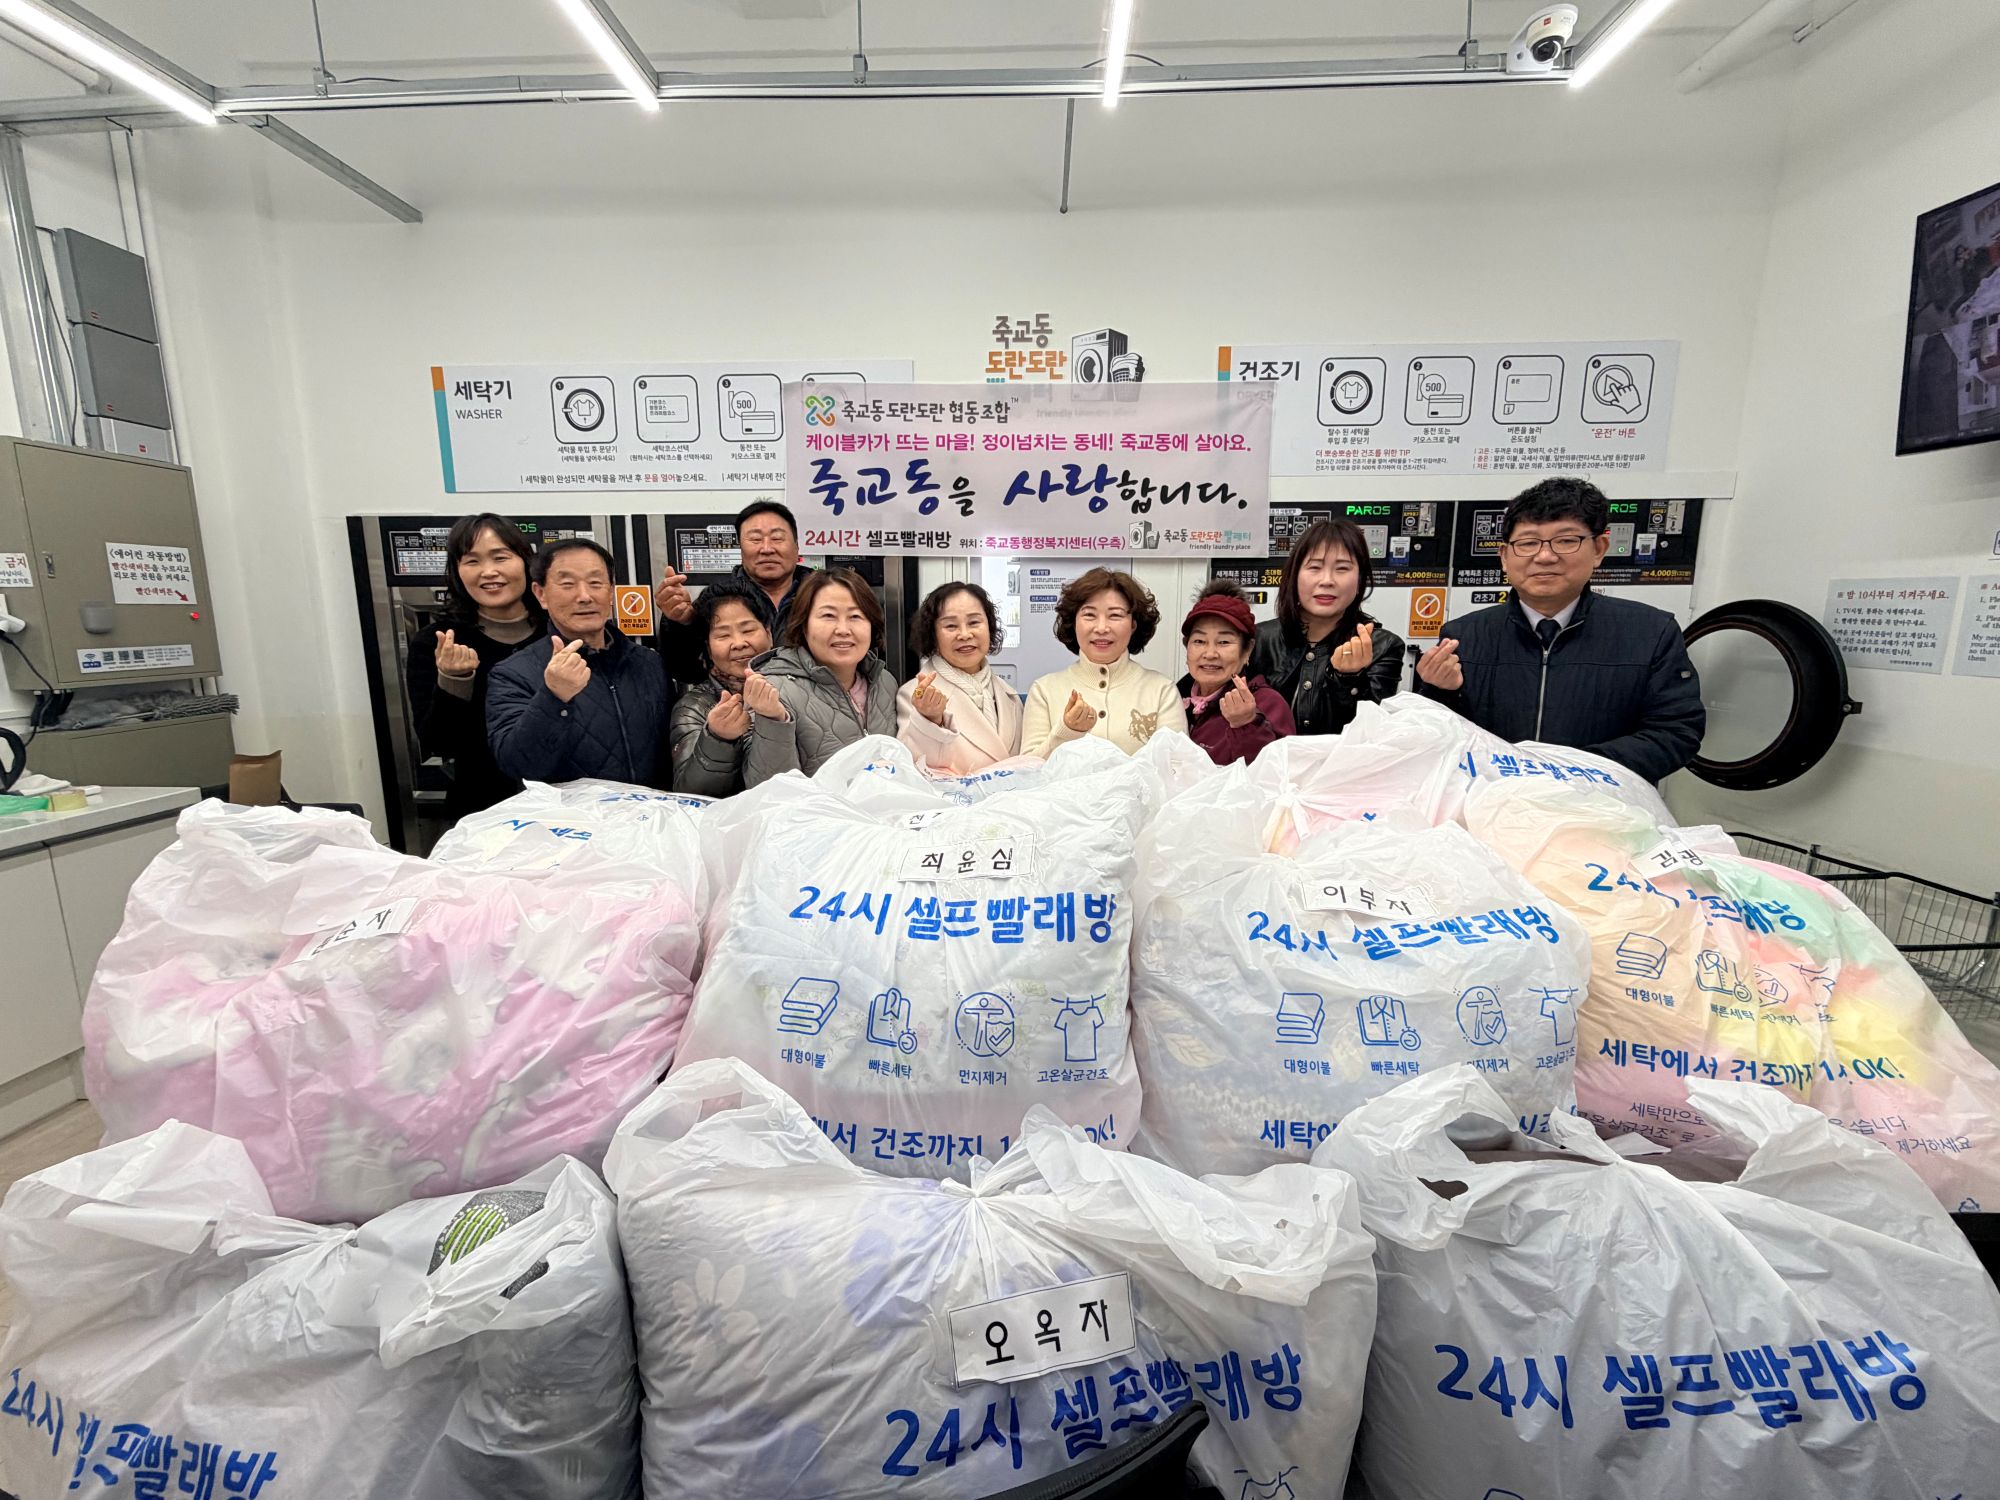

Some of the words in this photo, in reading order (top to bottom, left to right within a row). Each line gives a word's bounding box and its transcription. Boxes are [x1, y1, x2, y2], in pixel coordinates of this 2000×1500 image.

[992, 313, 1053, 349] 죽교동
[985, 351, 1068, 380] 도란도란
[455, 380, 512, 403] 세탁기
[1425, 382, 1441, 392] 500
[736, 400, 752, 409] 500
[455, 409, 503, 419] WASHER
[1413, 436, 1445, 444] 키오스크로
[1618, 428, 1637, 438] 버튼
[806, 433, 890, 452] 케이블카가
[895, 433, 929, 451] 뜨는
[935, 433, 975, 451] 마을!
[982, 433, 1068, 451] 정이넘치는
[1073, 432, 1113, 451] 동네!
[1120, 433, 1189, 452] 죽교동에
[1195, 433, 1252, 452] 살아요.
[731, 452, 762, 460] 키오스크로
[1324, 449, 1359, 457] 뽀송뽀송한
[525, 475, 554, 484] 세탁물이
[556, 474, 585, 483] 완성되면
[587, 474, 616, 483] 세탁물을
[618, 474, 632, 483] 꺼낸
[726, 473, 748, 482] 세탁기
[751, 472, 774, 481] 내부에
[808, 458, 976, 517] 죽교동을
[1002, 463, 1248, 514] 사랑합니다.
[1346, 505, 1391, 516] PAROS
[805, 530, 861, 547] 24시간
[866, 530, 952, 549] 셀프빨래방
[959, 538, 977, 549] 위치
[985, 536, 1126, 550] 죽교동행정복지센터(우측)
[1163, 529, 1187, 543] 죽교동
[1189, 529, 1222, 543] 도란도란
[1189, 543, 1212, 551] friendly
[1213, 543, 1234, 551] laundry
[1235, 543, 1251, 551] place
[5, 556, 27, 568] 금지
[135, 587, 174, 596] 빨간색버튼
[1257, 592, 1263, 604] 1
[1473, 593, 1496, 602] 건조기
[1498, 592, 1507, 603] 2
[1858, 590, 1895, 599] 10시부터
[1898, 590, 1949, 600] 지켜주세요.
[789, 886, 892, 936] 24시
[903, 892, 1117, 944] 셀프빨래방
[1246, 911, 1339, 961] 24시
[1352, 904, 1560, 961] 셀프빨래방
[1625, 987, 1675, 1008] 대형이불
[1710, 1003, 1755, 1022] 빠른세탁
[780, 1048, 825, 1069] 대형이불
[1599, 1038, 1718, 1079] 세탁에서
[1853, 1057, 1905, 1081] OK!
[868, 1059, 913, 1079] 빠른세탁
[1284, 1058, 1331, 1076] 대형이불
[1370, 1060, 1420, 1075] 빠른세탁
[958, 1069, 1007, 1086] 먼지제거
[1036, 1068, 1109, 1083] 고온살균건조
[871, 1126, 983, 1165] 건조까지
[1898, 1136, 1973, 1155] 제거하세요
[1433, 1343, 1574, 1429] 24시
[1603, 1330, 1927, 1431] 셀프빨래방
[882, 1395, 1023, 1477] 24시
[1050, 1342, 1303, 1460] 셀프빨래방
